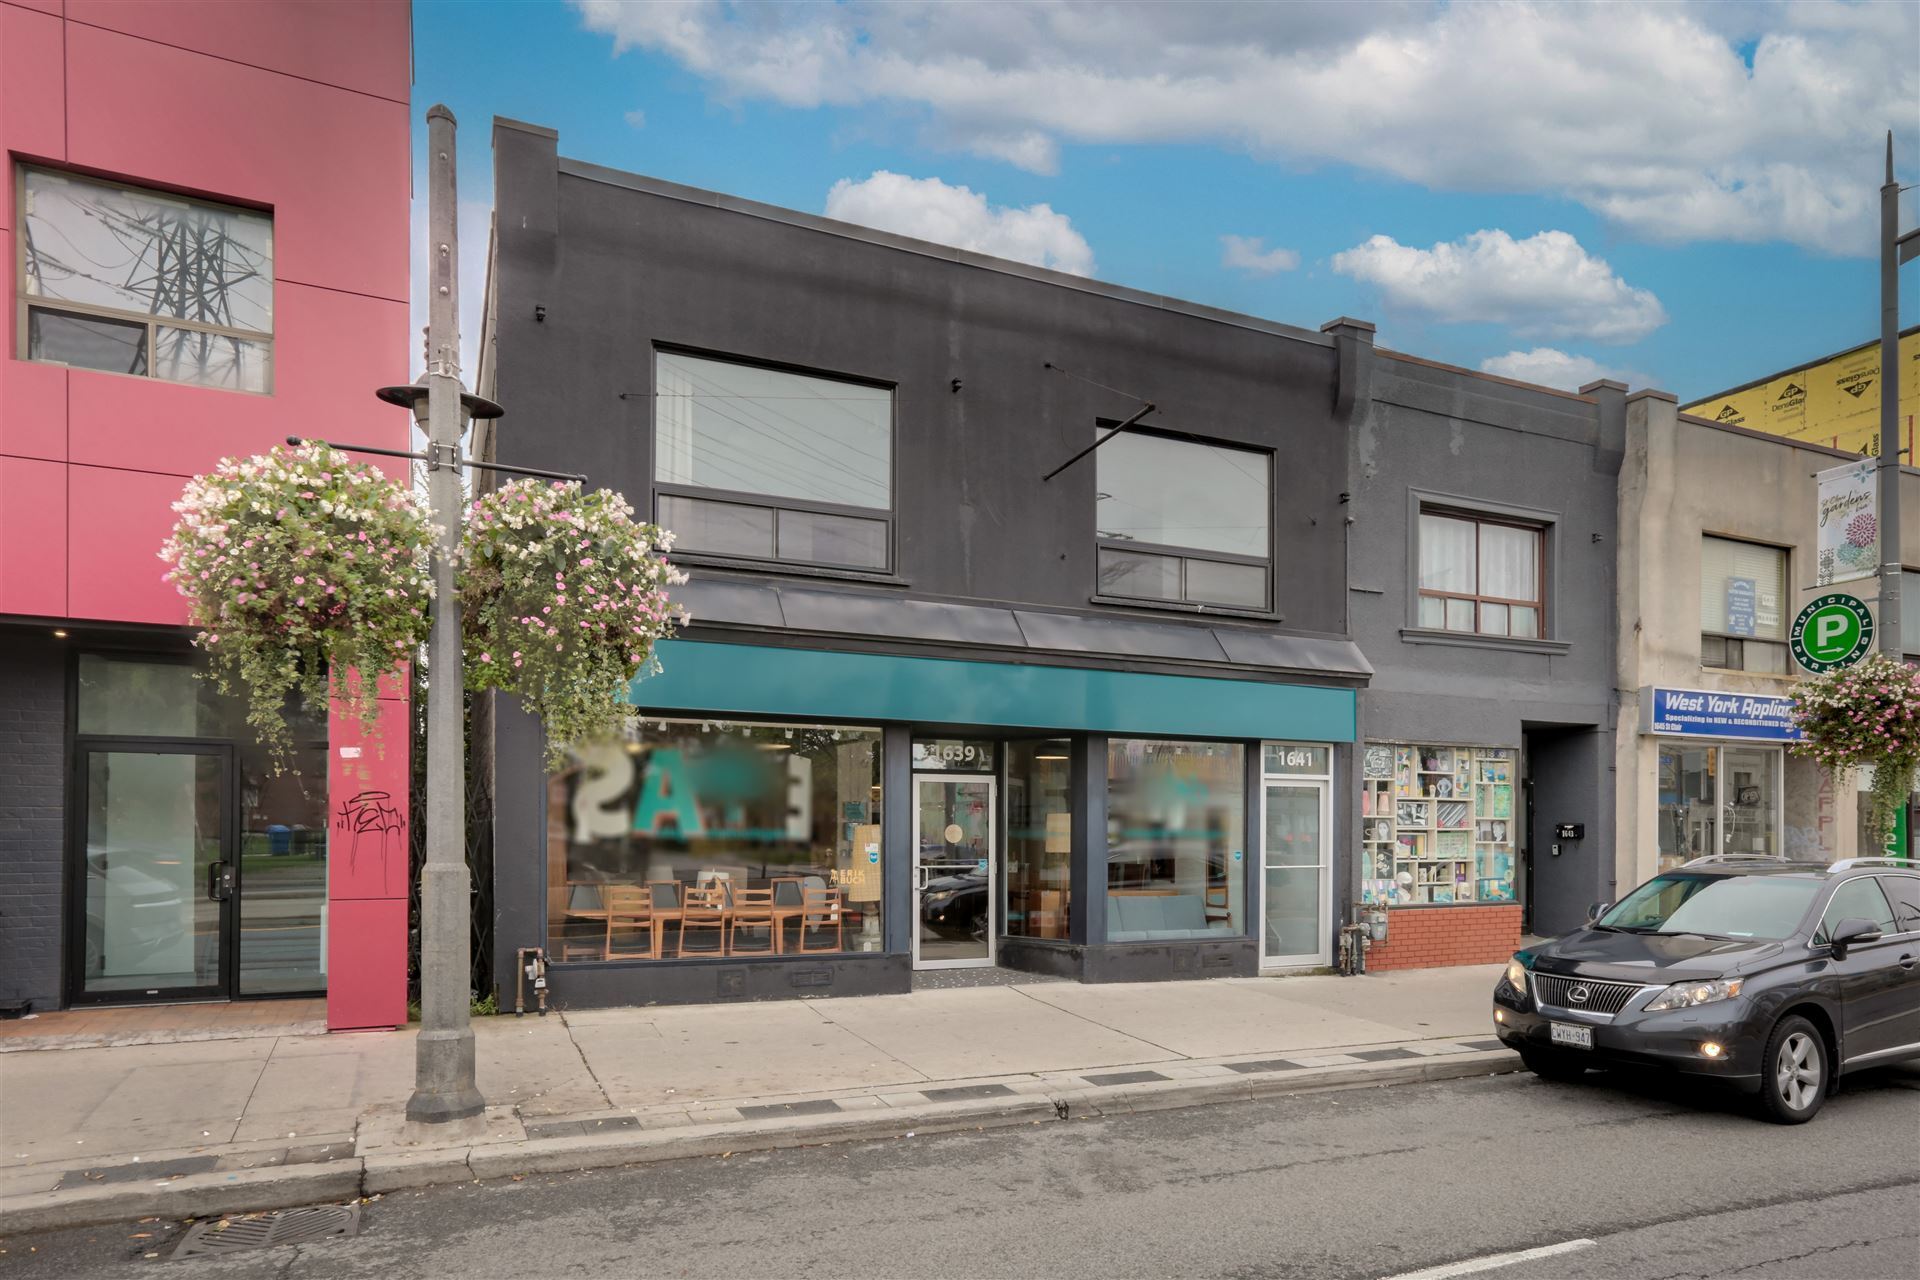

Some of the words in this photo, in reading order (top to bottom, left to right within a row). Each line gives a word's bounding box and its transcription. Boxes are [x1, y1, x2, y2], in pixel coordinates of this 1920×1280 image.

[1836, 367, 1880, 386] DensGlass
[1783, 387, 1799, 398] GP
[1850, 382, 1867, 394] GP
[1720, 408, 1734, 418] GP
[1871, 433, 1880, 456] Glass
[1820, 490, 1872, 528] gardens
[1794, 597, 1870, 636] MUNICIPAL
[1817, 613, 1849, 647] P
[1794, 637, 1869, 671] PARKING
[1665, 692, 1704, 711] West
[1707, 695, 1740, 715] York
[1741, 698, 1793, 720] Applian
[1665, 714, 1706, 724] Specializing
[1713, 716, 1728, 725] NEW
[1733, 718, 1779, 728] RECONDITIONED
[934, 744, 976, 762] 1639
[1278, 751, 1313, 767] 1641
